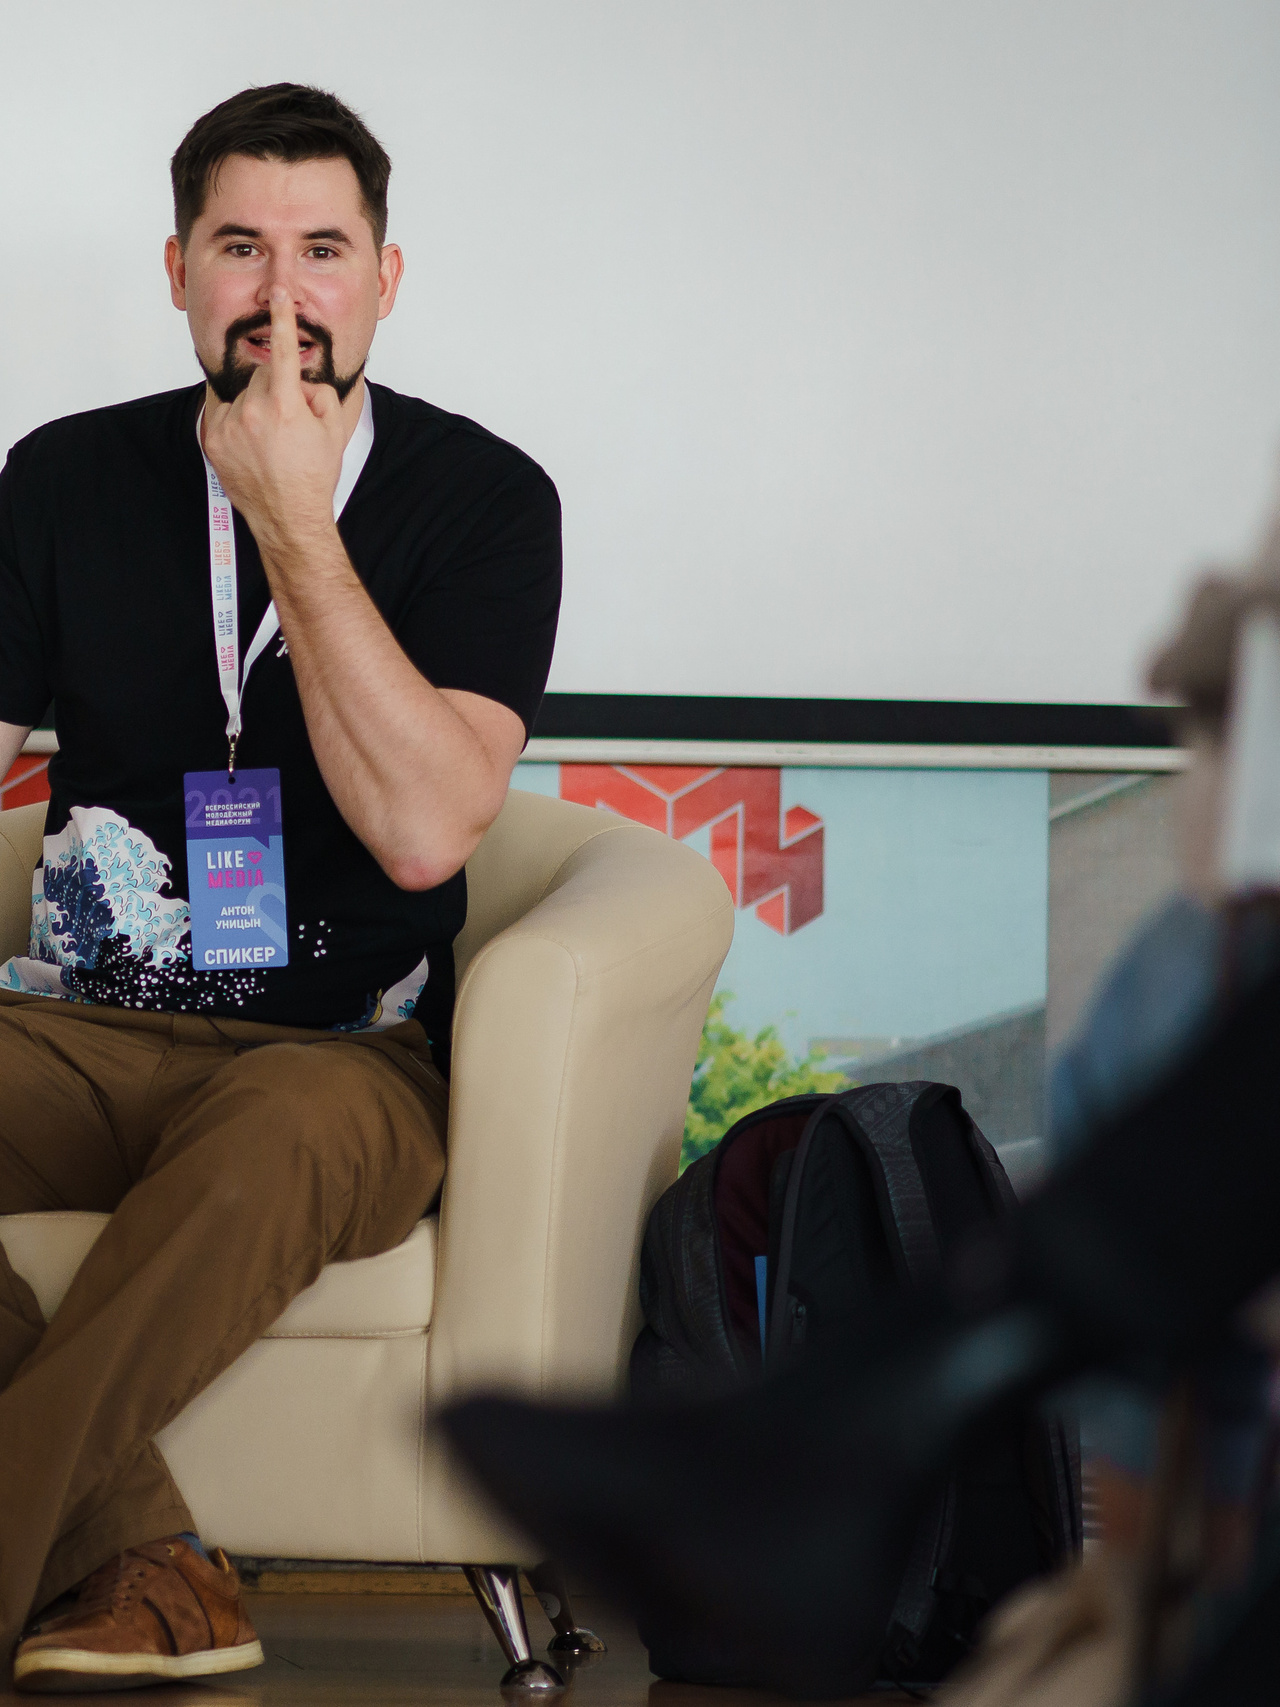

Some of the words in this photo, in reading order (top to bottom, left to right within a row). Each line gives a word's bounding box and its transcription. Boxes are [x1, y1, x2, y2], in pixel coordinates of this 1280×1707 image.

[213, 514, 221, 531] LIKE
[221, 507, 229, 531] MEDIA
[215, 547, 223, 566] LIKE
[223, 541, 231, 565] MEDIA
[216, 584, 224, 601] LIKE
[224, 575, 232, 600] MEDIA
[218, 619, 226, 637] LIKE
[226, 610, 234, 635] MEDIA
[220, 655, 228, 672] LIKE
[227, 645, 235, 670] MEDIA
[205, 802, 261, 812] ВСЕРОССИЙСКИЙ
[205, 810, 253, 819] МОЛОДЁЖНЫЙ
[205, 818, 251, 826] МЕДИАФОРУМ
[207, 850, 244, 869] LIKE
[208, 869, 264, 889] MEDIA
[221, 905, 255, 917] АНТОН
[215, 919, 261, 931] УНИЦЫН
[204, 946, 276, 966] СПИКЕР
